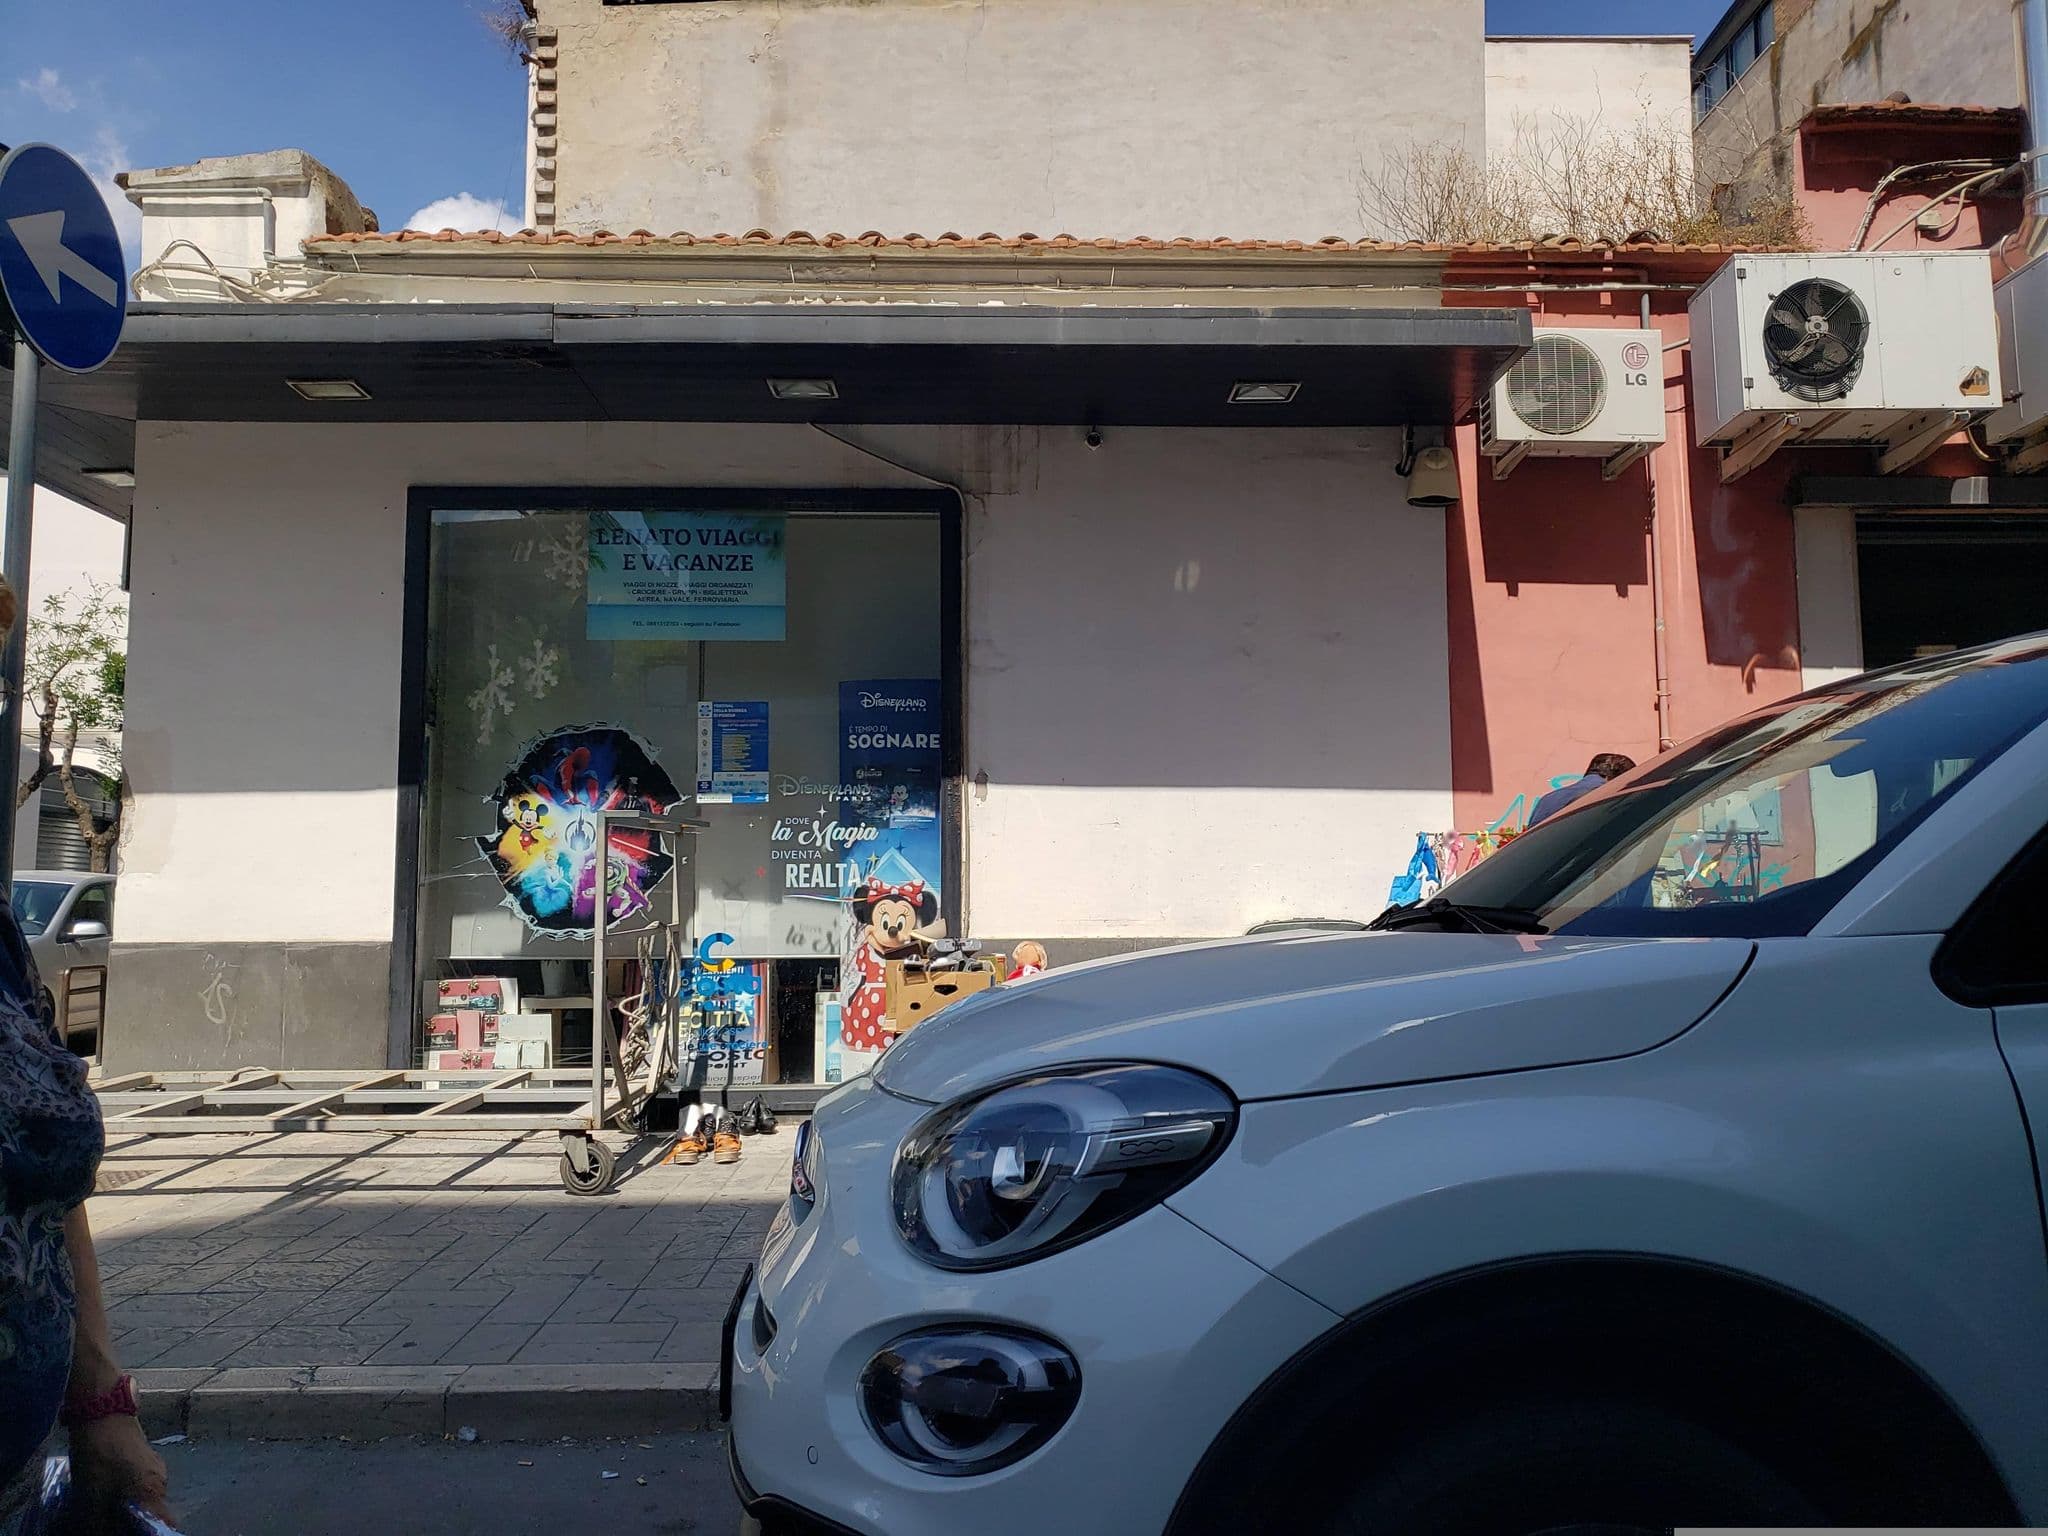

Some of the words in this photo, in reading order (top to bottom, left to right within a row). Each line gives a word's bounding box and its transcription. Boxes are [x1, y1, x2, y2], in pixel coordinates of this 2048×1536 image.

[1625, 373, 1648, 387] LG
[596, 528, 691, 547] LENATO
[695, 527, 779, 548] VIAGGI
[622, 553, 637, 572] E
[640, 553, 754, 572] VACANZE
[623, 581, 646, 589] VIAGGI
[855, 725, 879, 733] TEMPO
[880, 725, 888, 733] DI
[847, 733, 941, 749] SOGNARE
[785, 817, 810, 825] DOVE
[771, 820, 794, 841] la
[798, 820, 879, 852] Magia
[771, 850, 822, 860] DIVENTA
[785, 858, 863, 889] REALTÀ
[1119, 1138, 1176, 1156] 500
